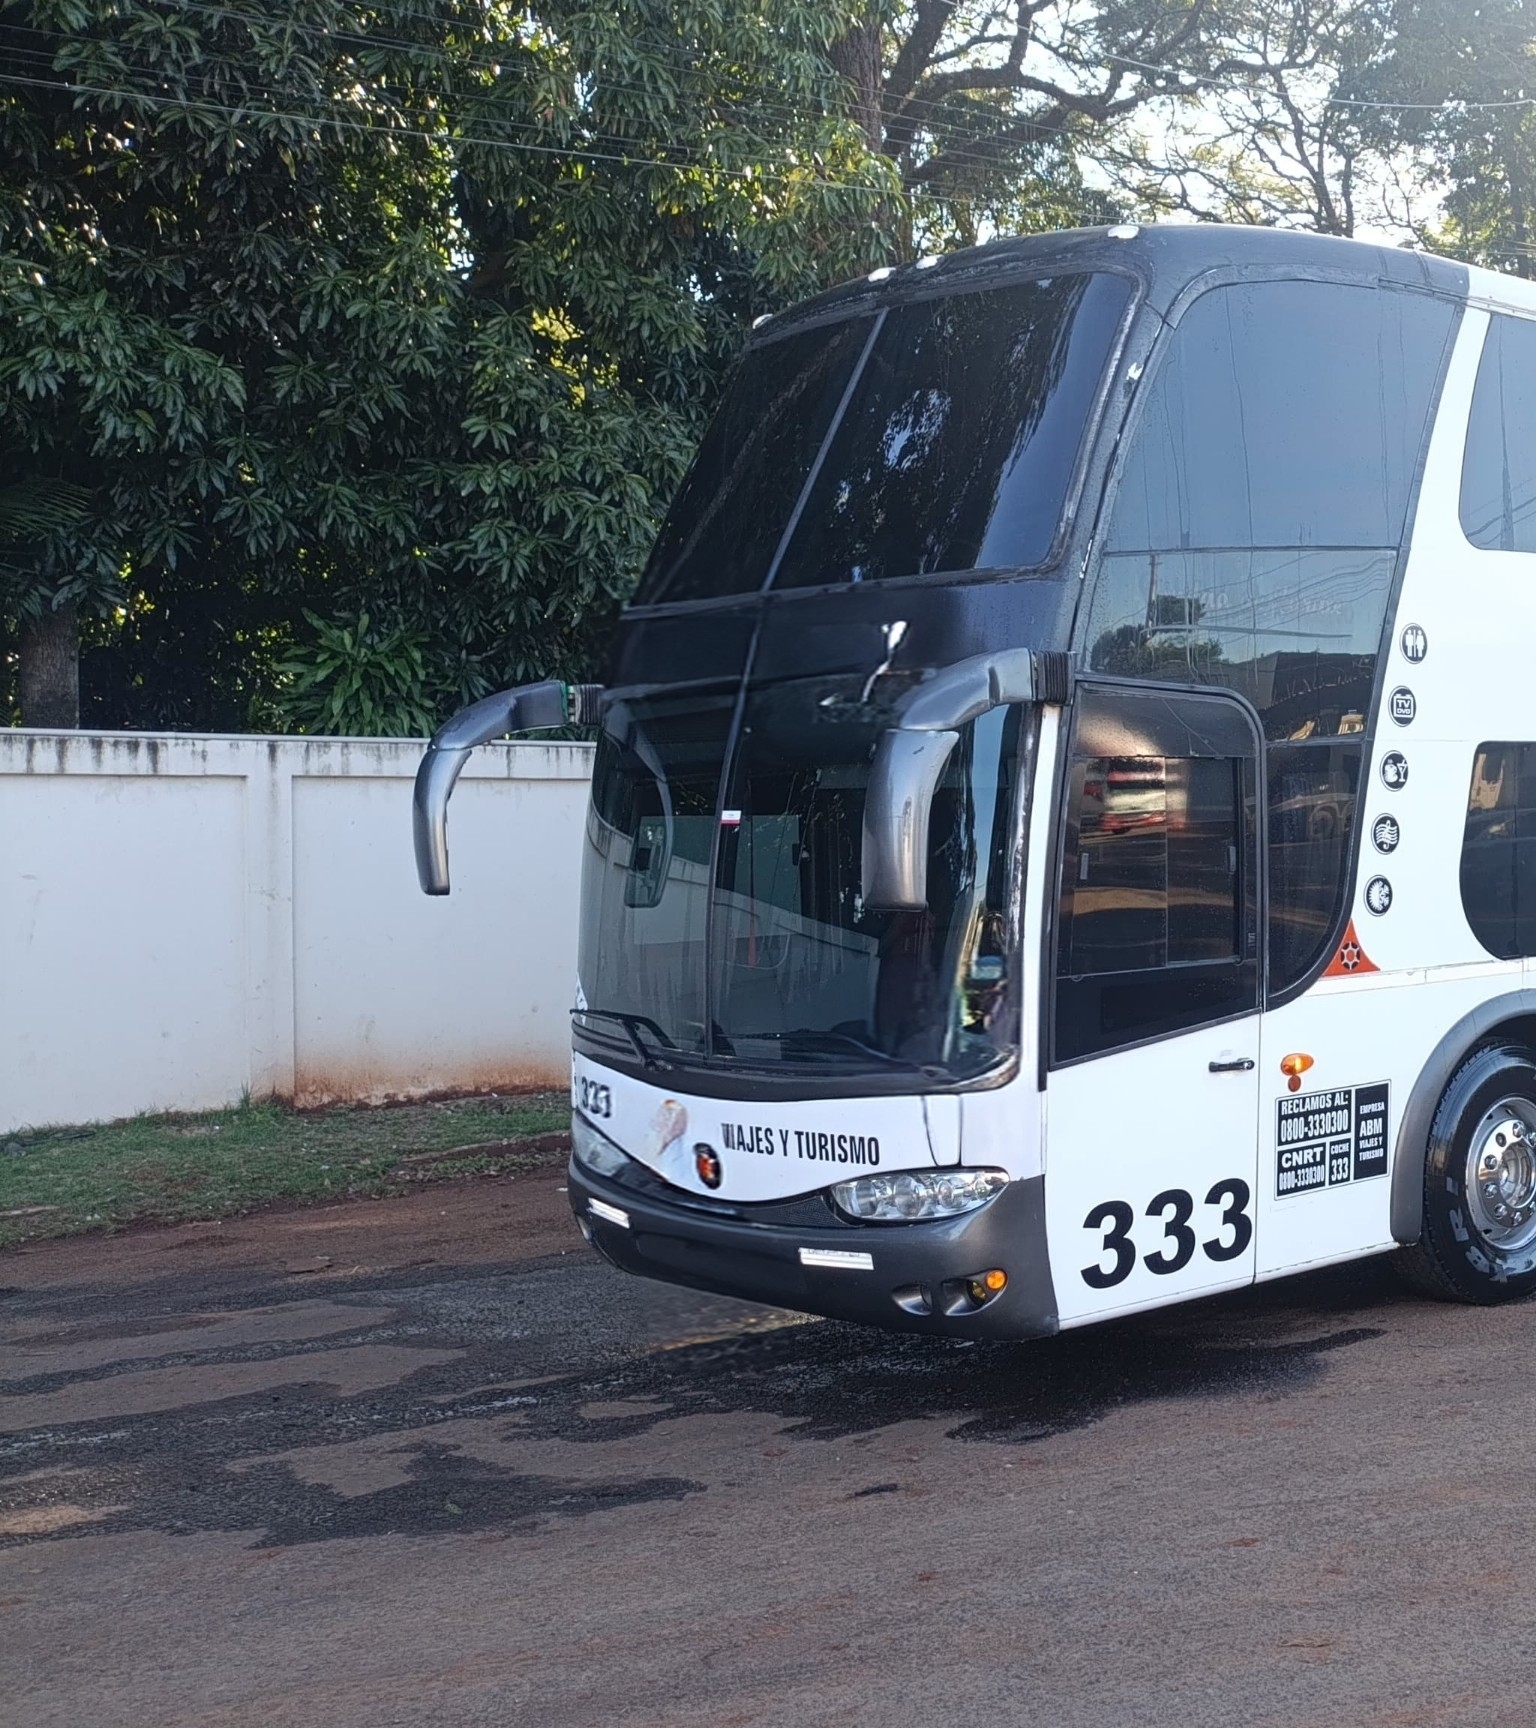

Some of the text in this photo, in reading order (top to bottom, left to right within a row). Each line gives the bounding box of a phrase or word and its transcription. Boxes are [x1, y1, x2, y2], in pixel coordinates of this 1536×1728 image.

[1397, 699, 1410, 708] TV
[1281, 1091, 1349, 1116] RECLAMOS AL:
[1360, 1101, 1385, 1114] EMPRESA
[1281, 1109, 1348, 1142] 0800-3330300
[1360, 1117, 1383, 1137] ABM
[721, 1123, 880, 1166] VIAJES Y TURISMO
[1331, 1142, 1349, 1155] COCHE
[1359, 1136, 1383, 1149] VIAJES Y
[1281, 1147, 1323, 1168] CNRT
[1359, 1148, 1384, 1161] TURISMO
[1331, 1157, 1349, 1181] 333
[1080, 1177, 1253, 1289] 333
